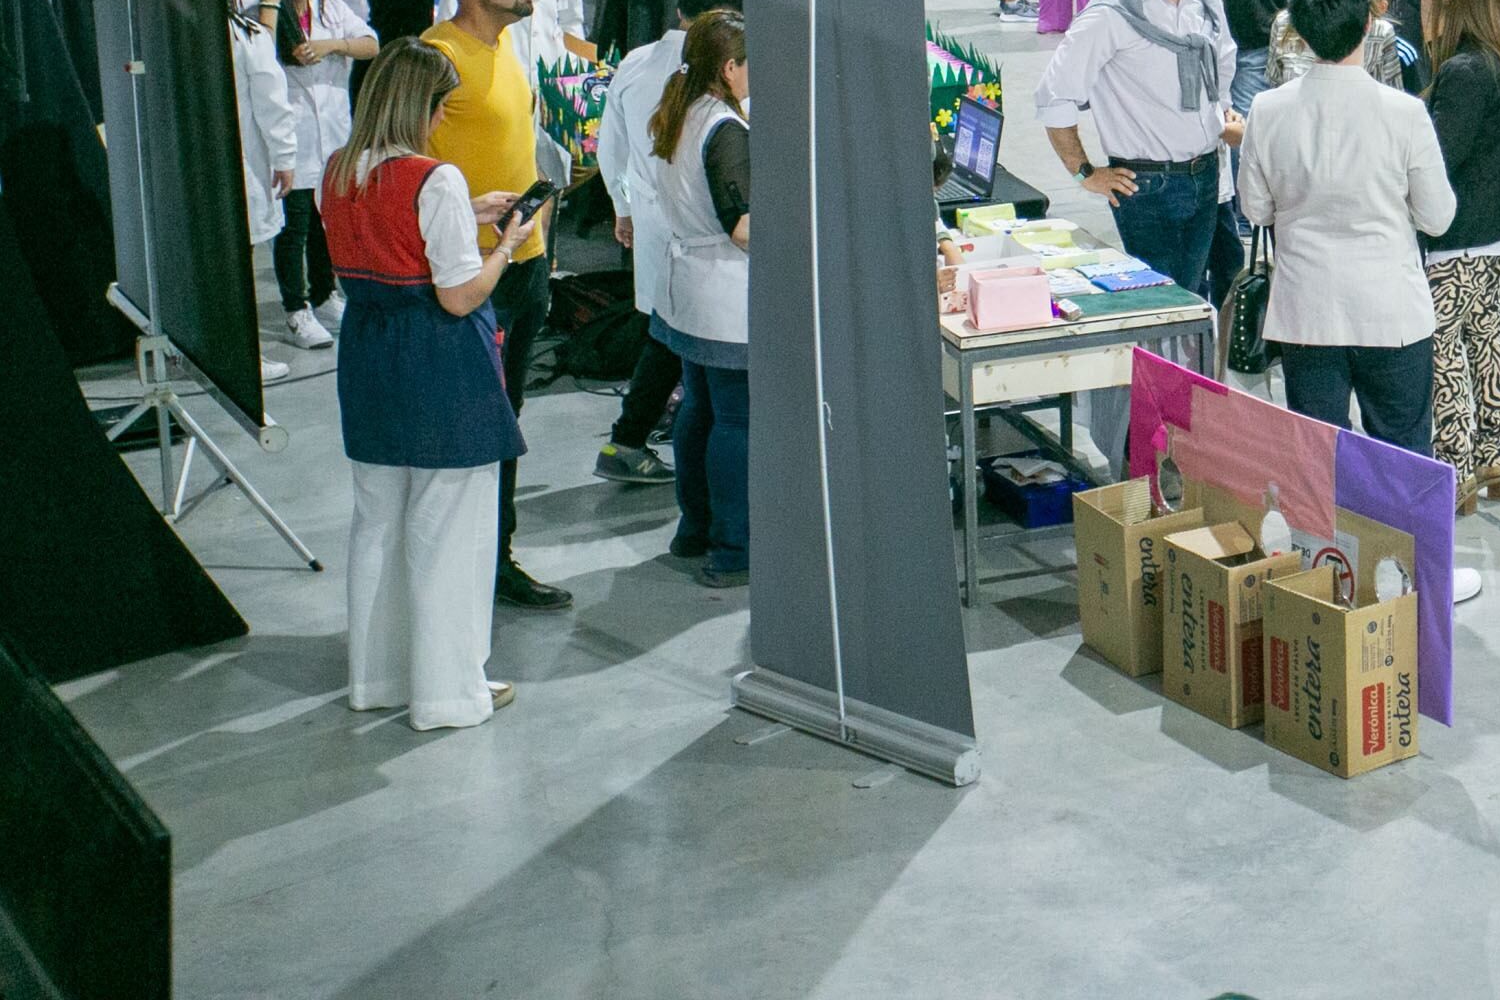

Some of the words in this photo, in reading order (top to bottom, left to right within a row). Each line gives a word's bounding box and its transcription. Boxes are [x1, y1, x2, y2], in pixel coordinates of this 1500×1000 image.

[1139, 536, 1161, 606] entera
[1182, 572, 1198, 674] entera
[1302, 635, 1322, 741] entera
[1367, 684, 1379, 755] Verónica
[1393, 672, 1412, 747] entera
